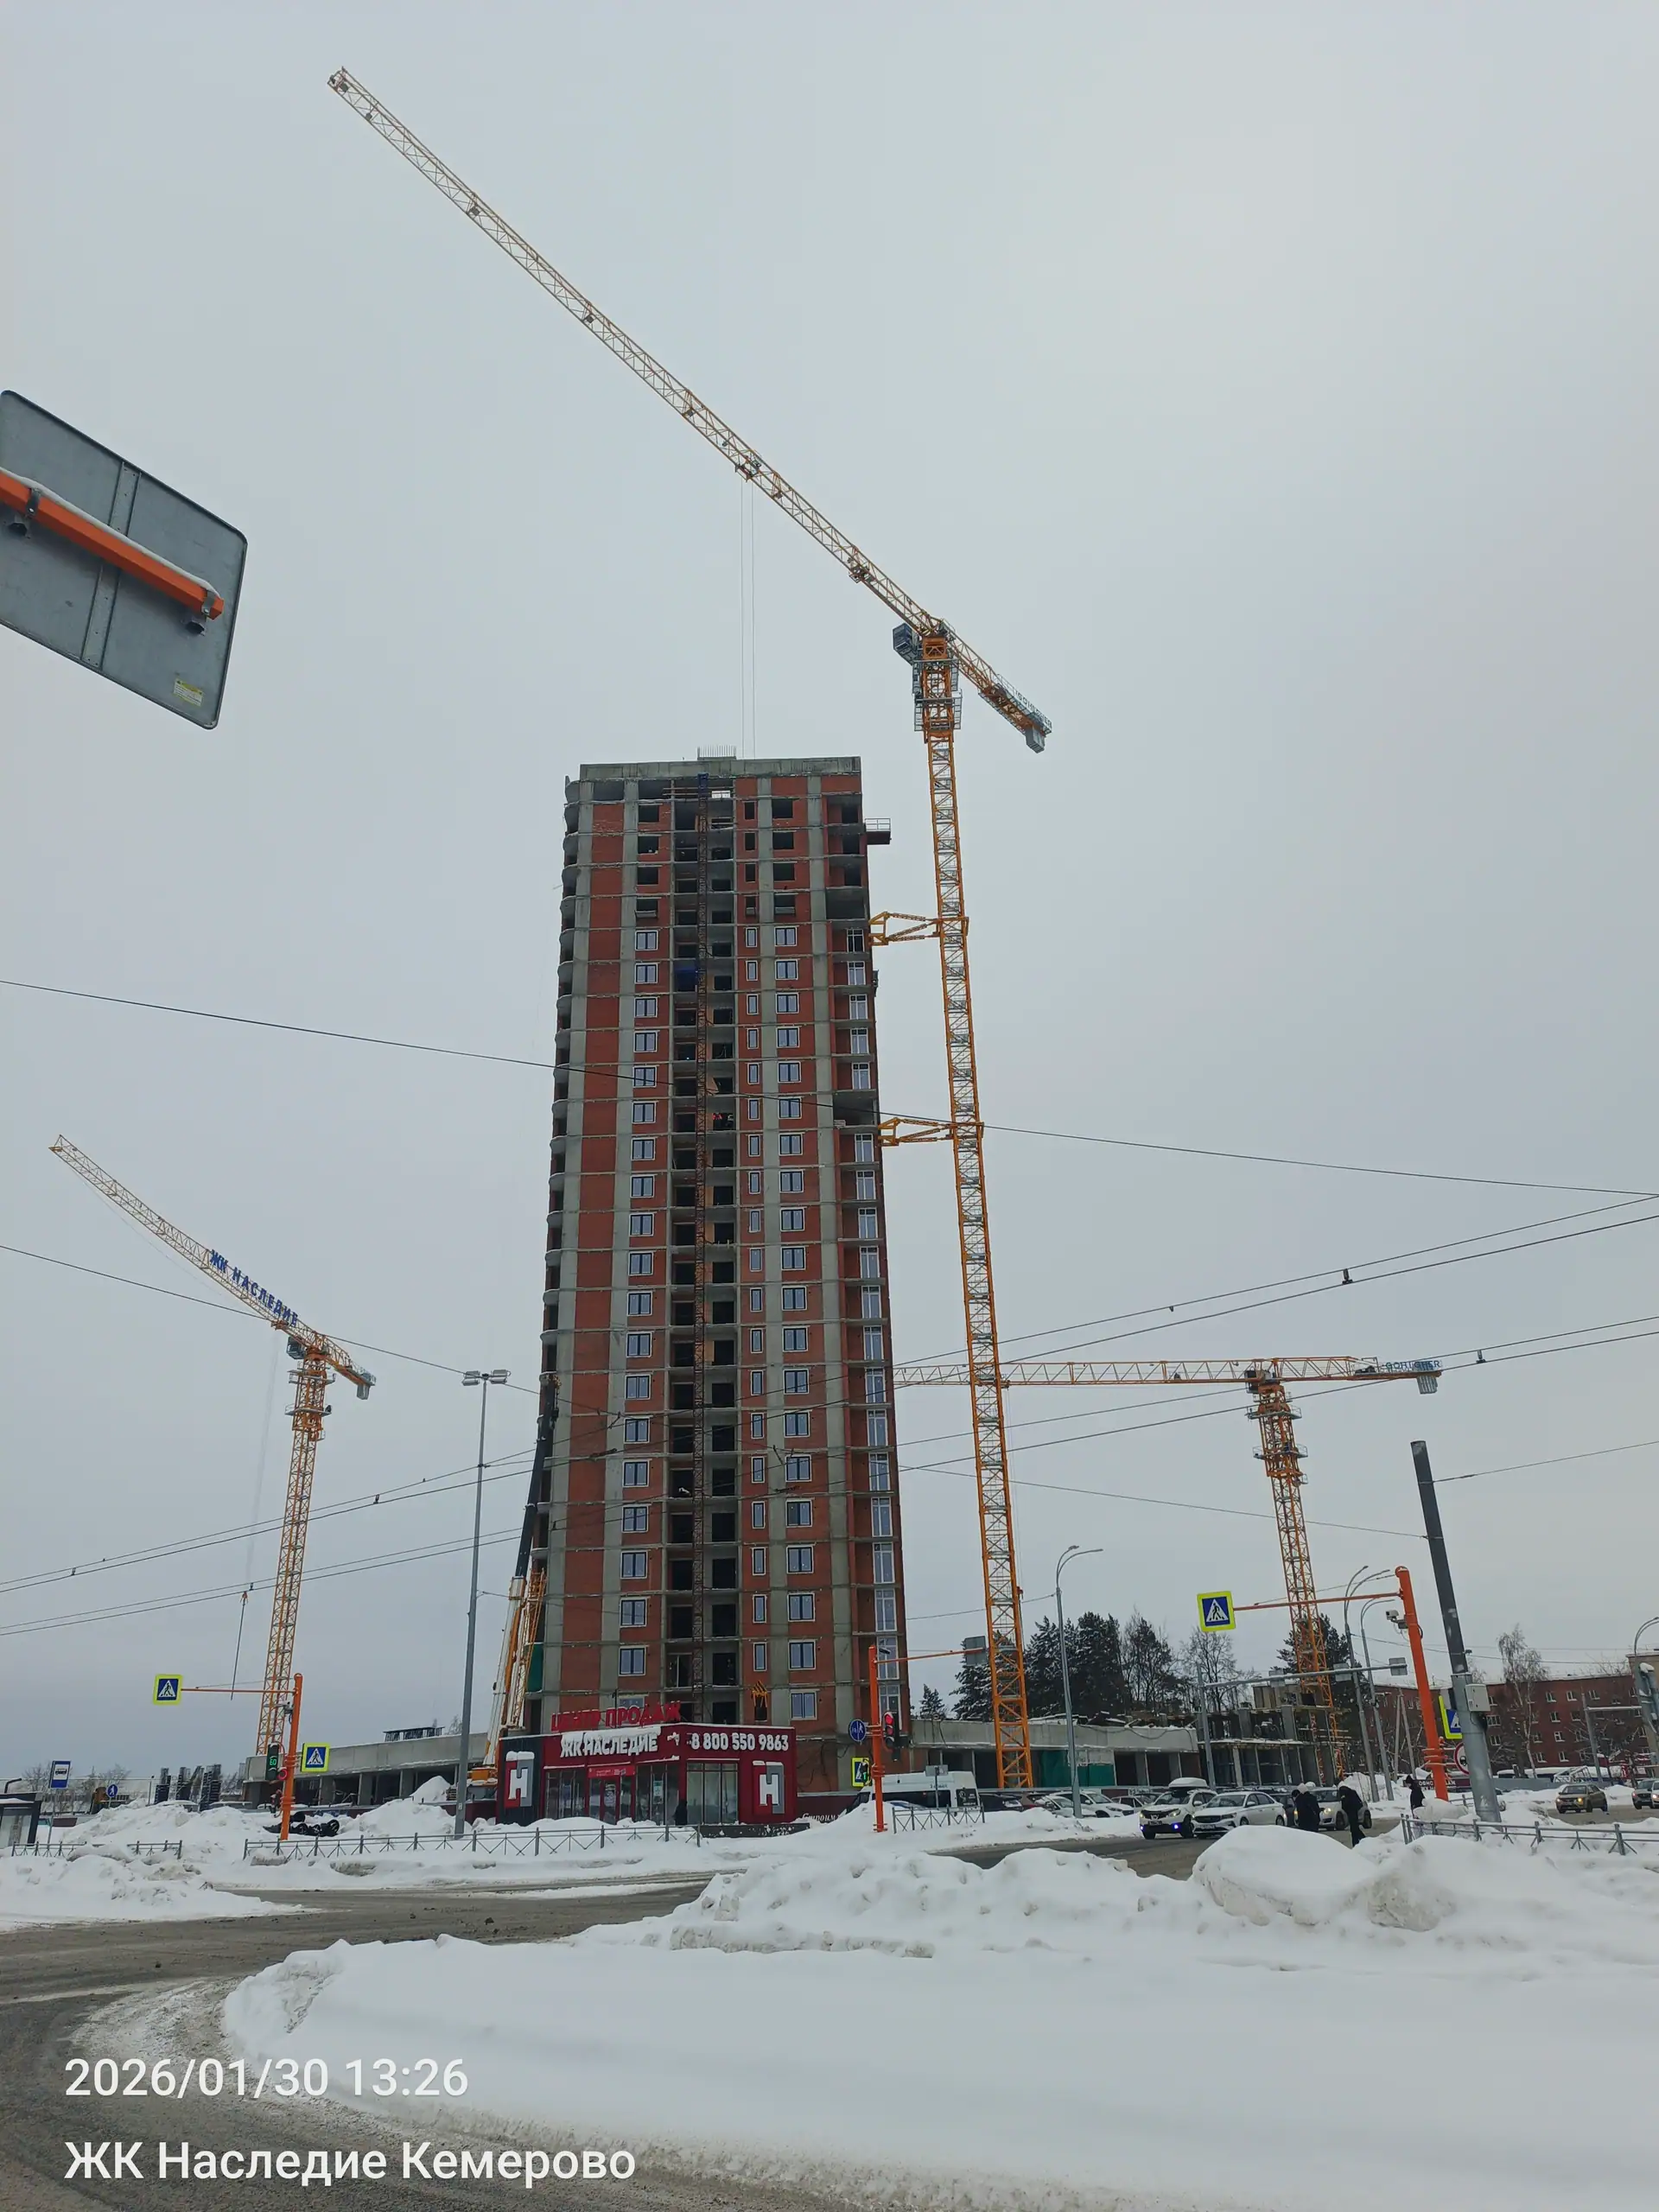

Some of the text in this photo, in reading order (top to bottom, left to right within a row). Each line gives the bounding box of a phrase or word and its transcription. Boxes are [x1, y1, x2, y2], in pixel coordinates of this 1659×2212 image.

[210, 1249, 298, 1327] ЖК НАСЛЕДИЕ
[606, 1701, 681, 1728] ПРОДАЖ
[560, 1733, 658, 1758] ЖК НАСЛЕДИЕ
[691, 1732, 789, 1751] 8 800 550 9863
[508, 1768, 529, 1800] Н
[760, 1774, 779, 1806] Н
